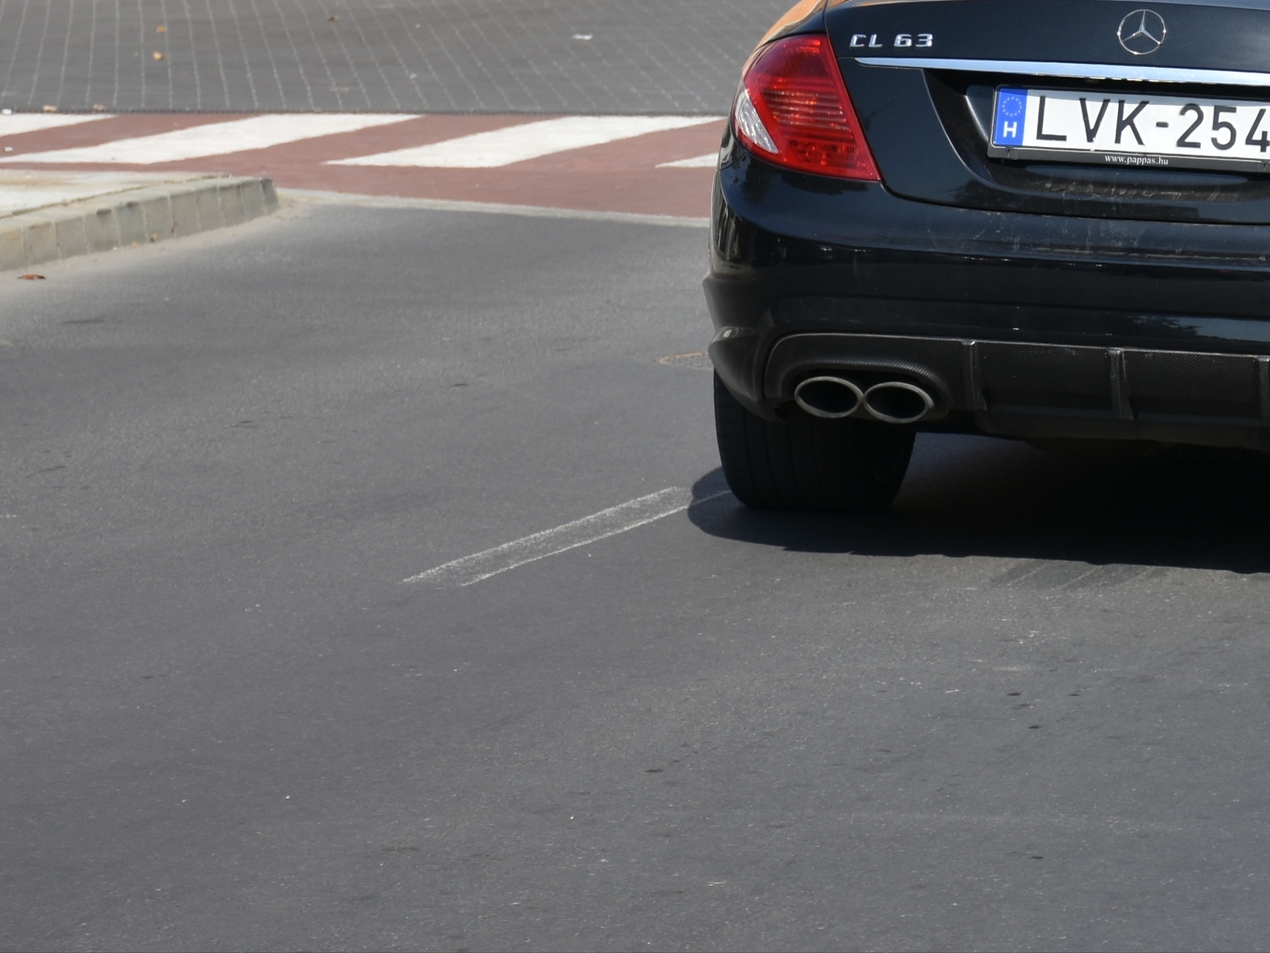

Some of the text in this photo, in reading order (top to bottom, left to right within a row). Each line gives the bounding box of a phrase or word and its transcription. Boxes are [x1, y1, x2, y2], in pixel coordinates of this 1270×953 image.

[849, 33, 934, 48] CL 63
[1002, 121, 1018, 139] H
[1035, 94, 1270, 154] LVK-254
[1104, 153, 1169, 166] www.pappas.hu
